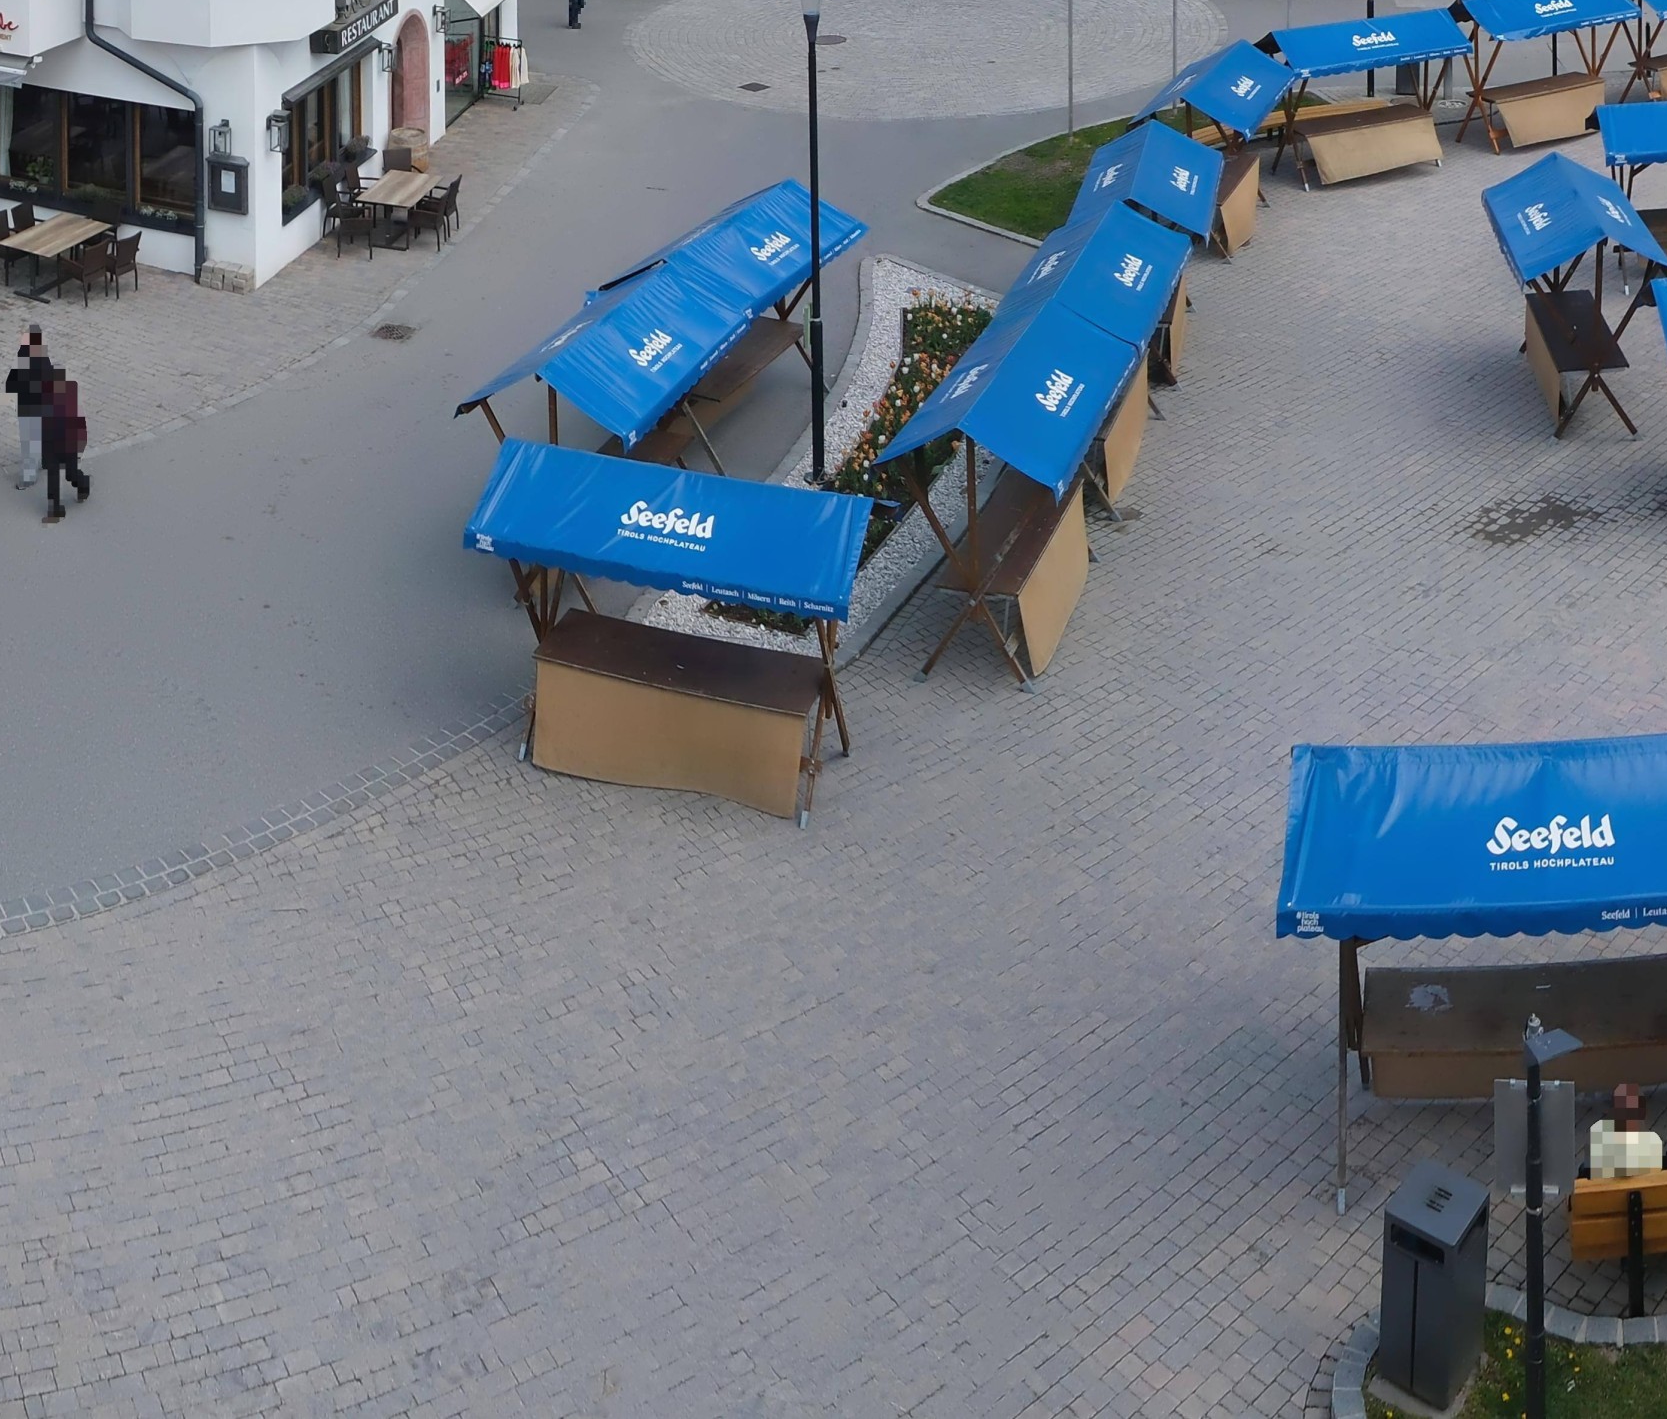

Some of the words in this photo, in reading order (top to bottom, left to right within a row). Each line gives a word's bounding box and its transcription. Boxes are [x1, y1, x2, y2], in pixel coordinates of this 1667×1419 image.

[1352, 30, 1397, 48] Seefeld
[1230, 74, 1255, 98] Seefeld
[1169, 165, 1190, 193] Seefeld
[1524, 202, 1552, 231] Seefeld
[749, 230, 792, 263] Seefeld
[1113, 252, 1144, 288] Seefeld
[628, 328, 673, 367] Seefeld
[1034, 368, 1075, 413] Seefeld
[621, 500, 715, 540] Seefeld
[616, 527, 645, 541] TIROLS
[647, 533, 706, 552] HOCHPLATEAU
[682, 580, 703, 592] Seefeld
[1485, 813, 1615, 856] Seefeld
[1488, 859, 1530, 871] TIROLS
[1533, 856, 1615, 869] HOCHPLATEAU
[1295, 910, 1320, 921] #tirols
[1301, 917, 1318, 927] hoch
[1601, 907, 1630, 921] Seefeld
[1296, 924, 1325, 934] plateau
